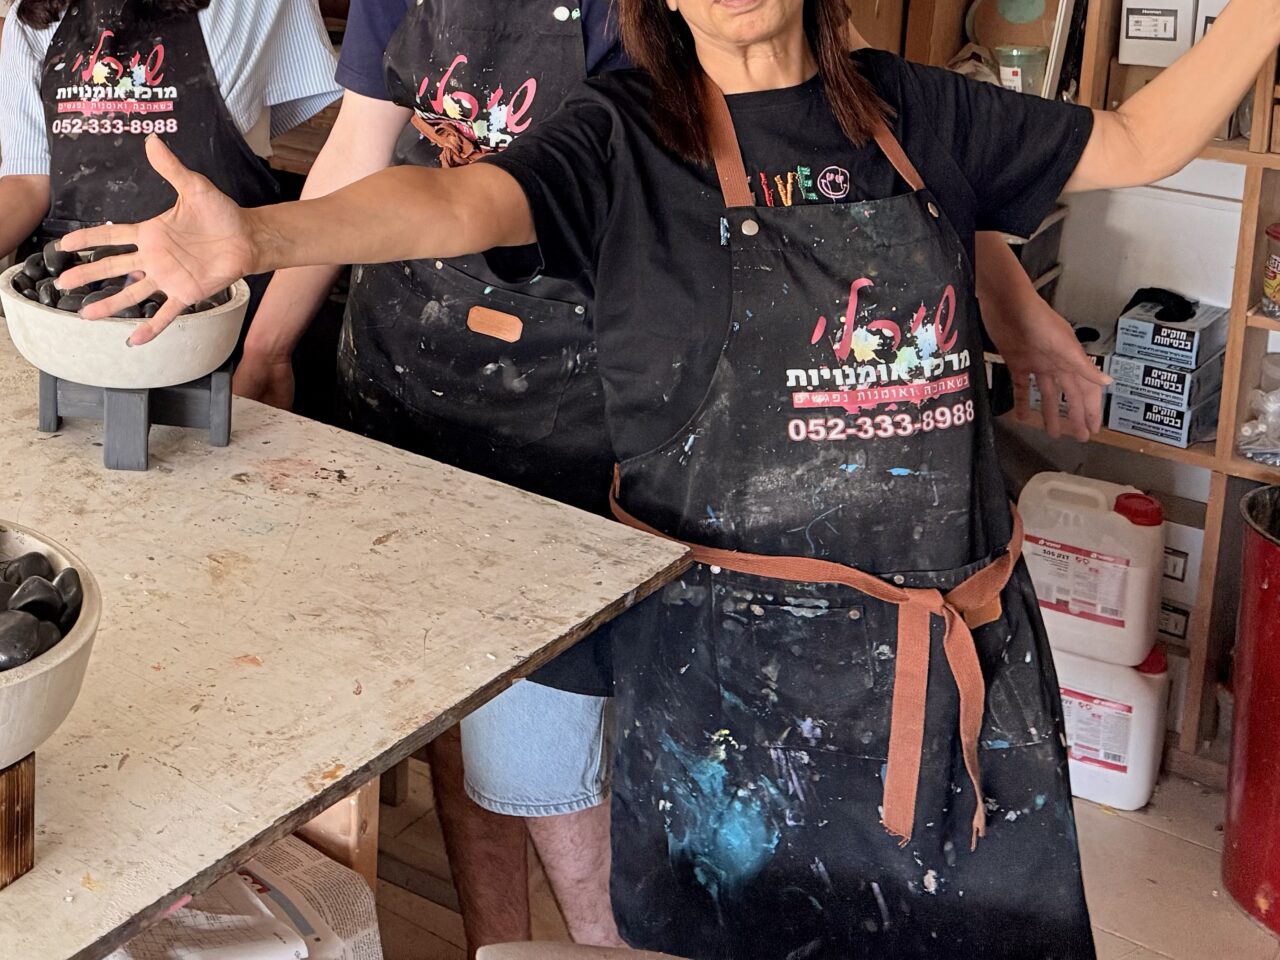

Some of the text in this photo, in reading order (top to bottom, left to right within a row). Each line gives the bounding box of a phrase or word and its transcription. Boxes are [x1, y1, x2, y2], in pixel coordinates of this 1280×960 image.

[55, 85, 126, 100] אומנויות
[51, 118, 179, 135] 052-333-8988
[1160, 327, 1188, 340] חזקים
[1153, 334, 1192, 350] בבטיחות
[785, 361, 911, 388] אומנויות
[1151, 368, 1178, 383] חזקים
[1144, 376, 1183, 393] בבטיחות
[1152, 404, 1177, 418] חזקים
[787, 399, 976, 442] 052-333-8988
[1145, 411, 1182, 428] בבטיחות
